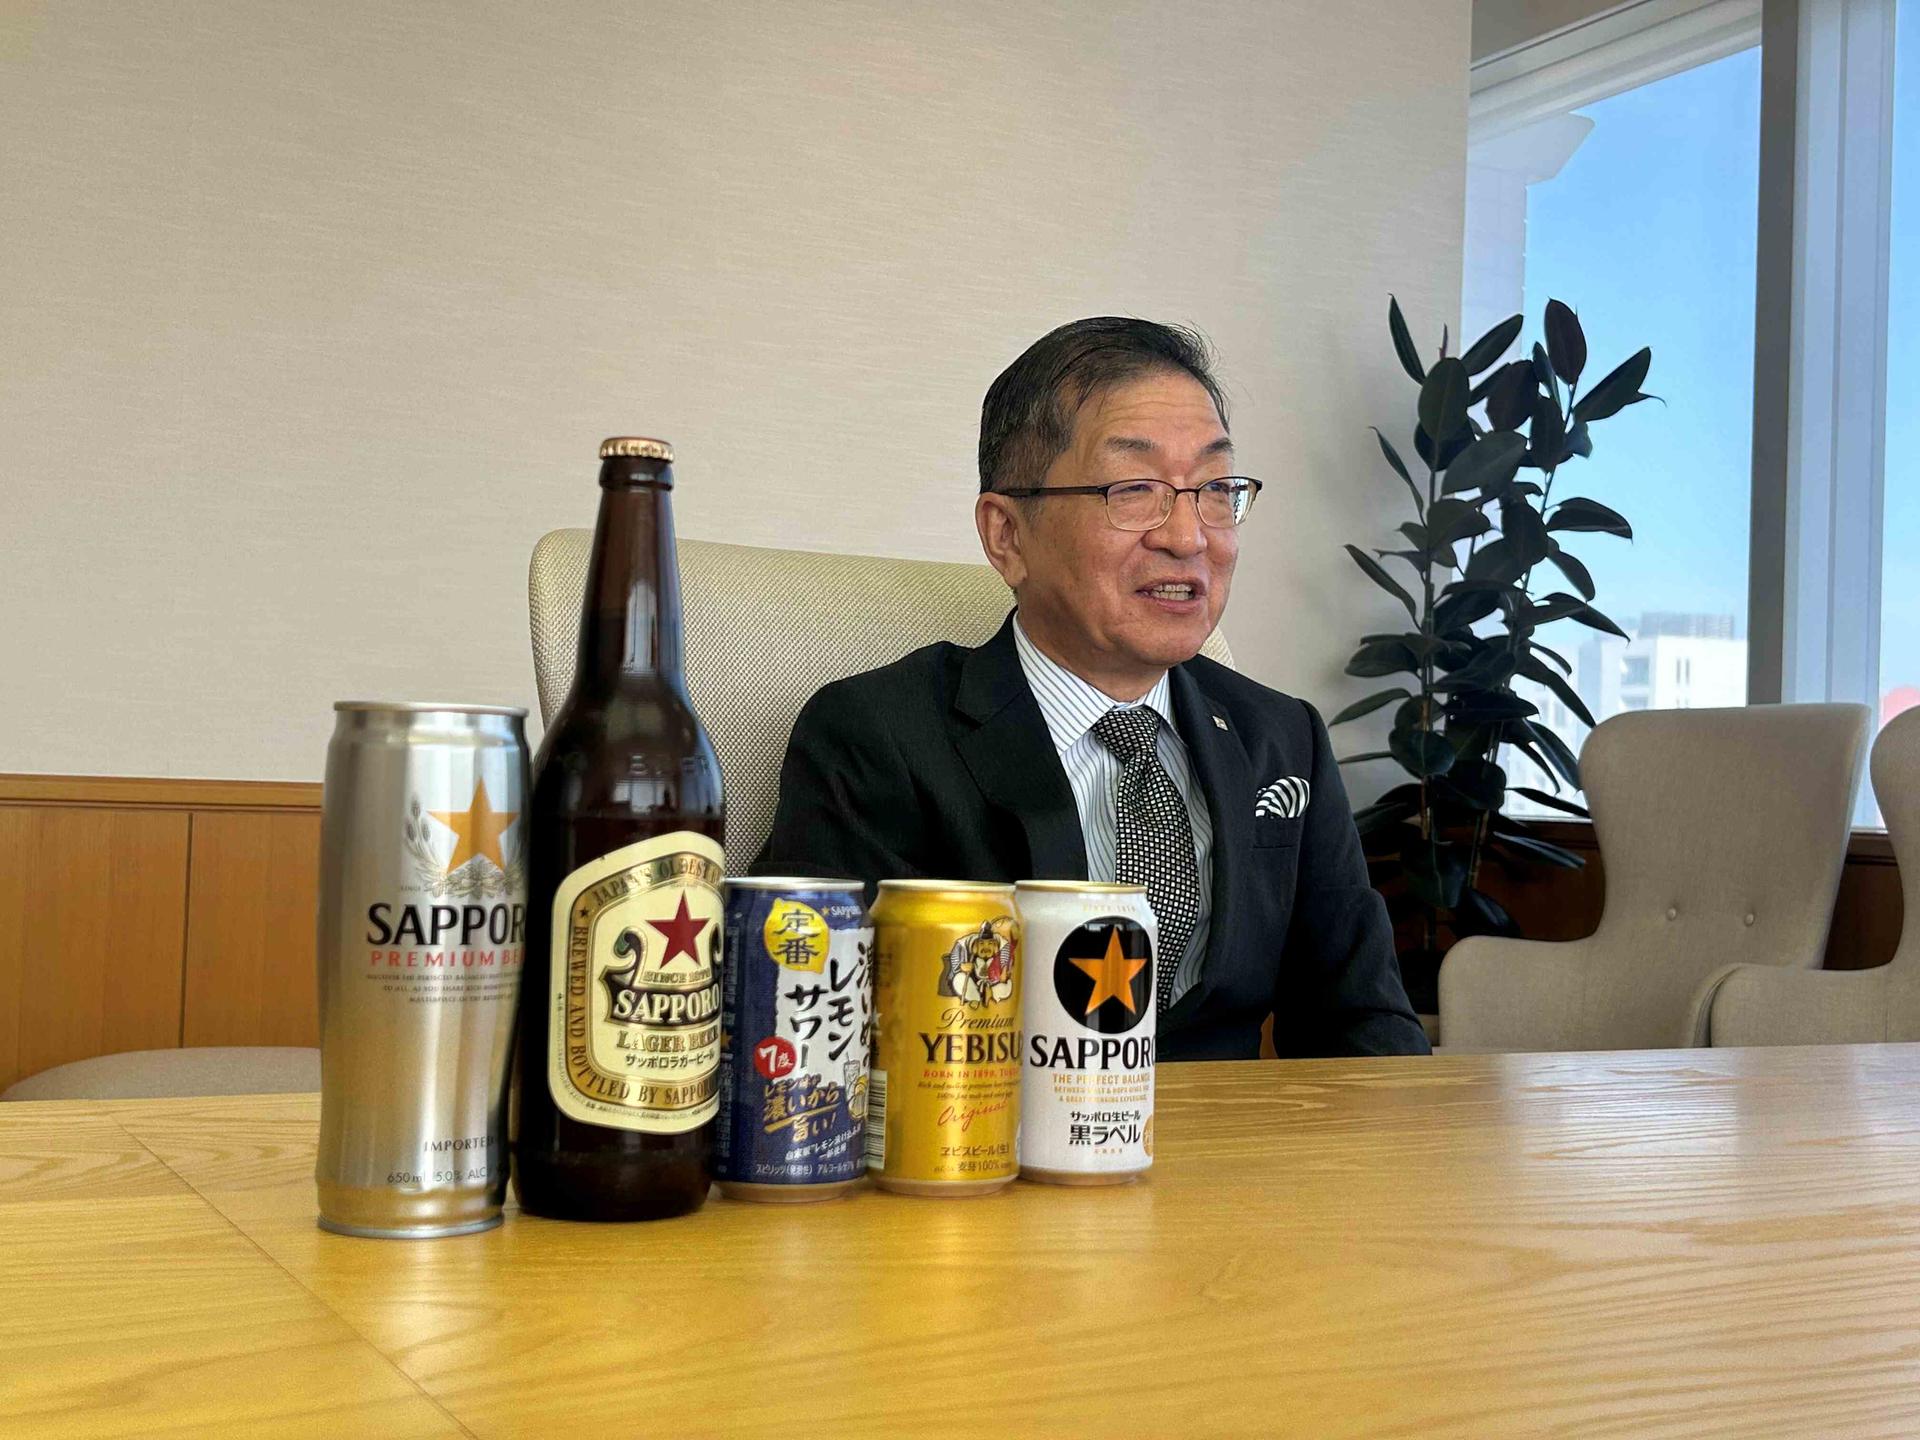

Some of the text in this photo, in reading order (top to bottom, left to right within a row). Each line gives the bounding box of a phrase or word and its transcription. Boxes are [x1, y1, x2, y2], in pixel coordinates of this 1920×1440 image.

[773, 909, 821, 965] 定番
[371, 950, 495, 968] PREMIUM
[570, 926, 589, 996] BREWED
[613, 983, 720, 1023] SAPPORO
[570, 1003, 586, 1038] AND
[937, 1007, 1014, 1031] Premium
[617, 1030, 686, 1053] LAGER
[919, 1031, 1024, 1065] YEBISU
[625, 1049, 714, 1068] サッポロラガービール
[571, 1045, 631, 1100] BOTTLED
[1052, 1073, 1073, 1083] THE
[1077, 1074, 1119, 1085] PEFECT
[638, 1084, 657, 1104] BY
[1070, 1110, 1141, 1122] サッポロ生ビール
[1069, 1124, 1141, 1145] 黒ラベル
